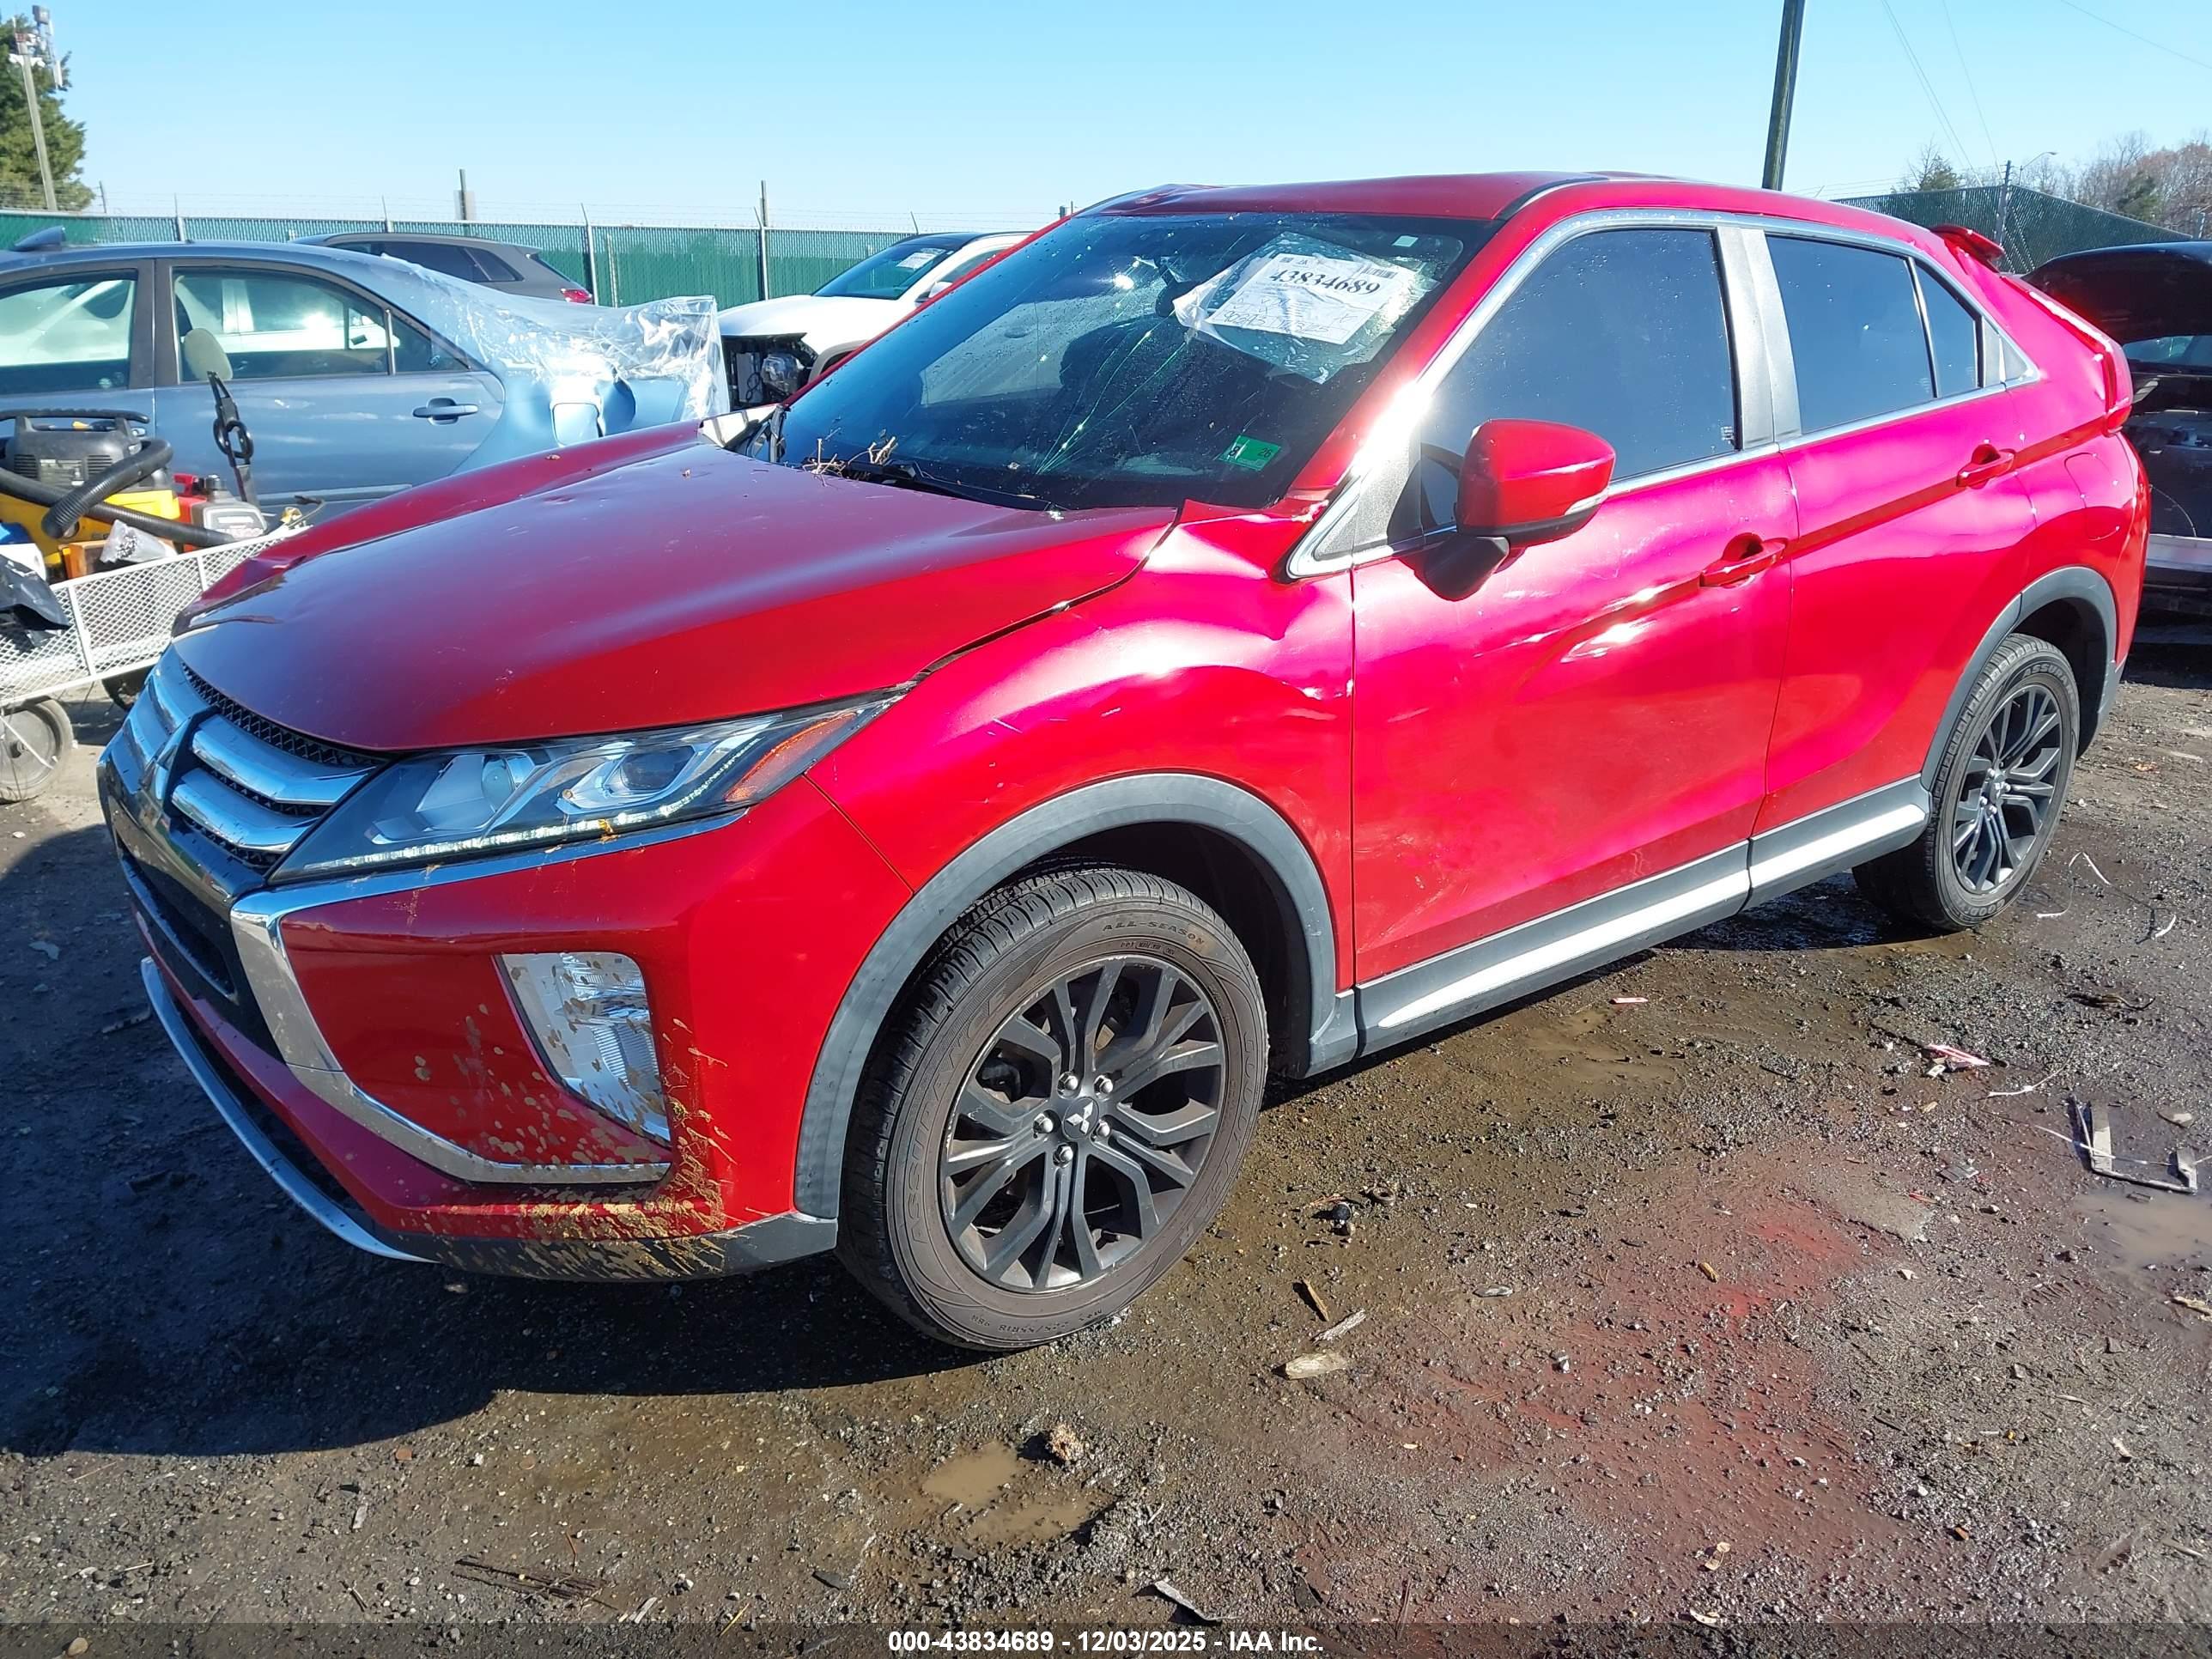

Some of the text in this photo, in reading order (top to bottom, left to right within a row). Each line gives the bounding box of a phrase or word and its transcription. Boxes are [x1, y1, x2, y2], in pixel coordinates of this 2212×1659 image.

[1269, 270, 1381, 295] 43834689
[1229, 446, 1241, 457] 8
[1257, 447, 1272, 459] 26
[1102, 921, 1205, 945] ALL-SEASON
